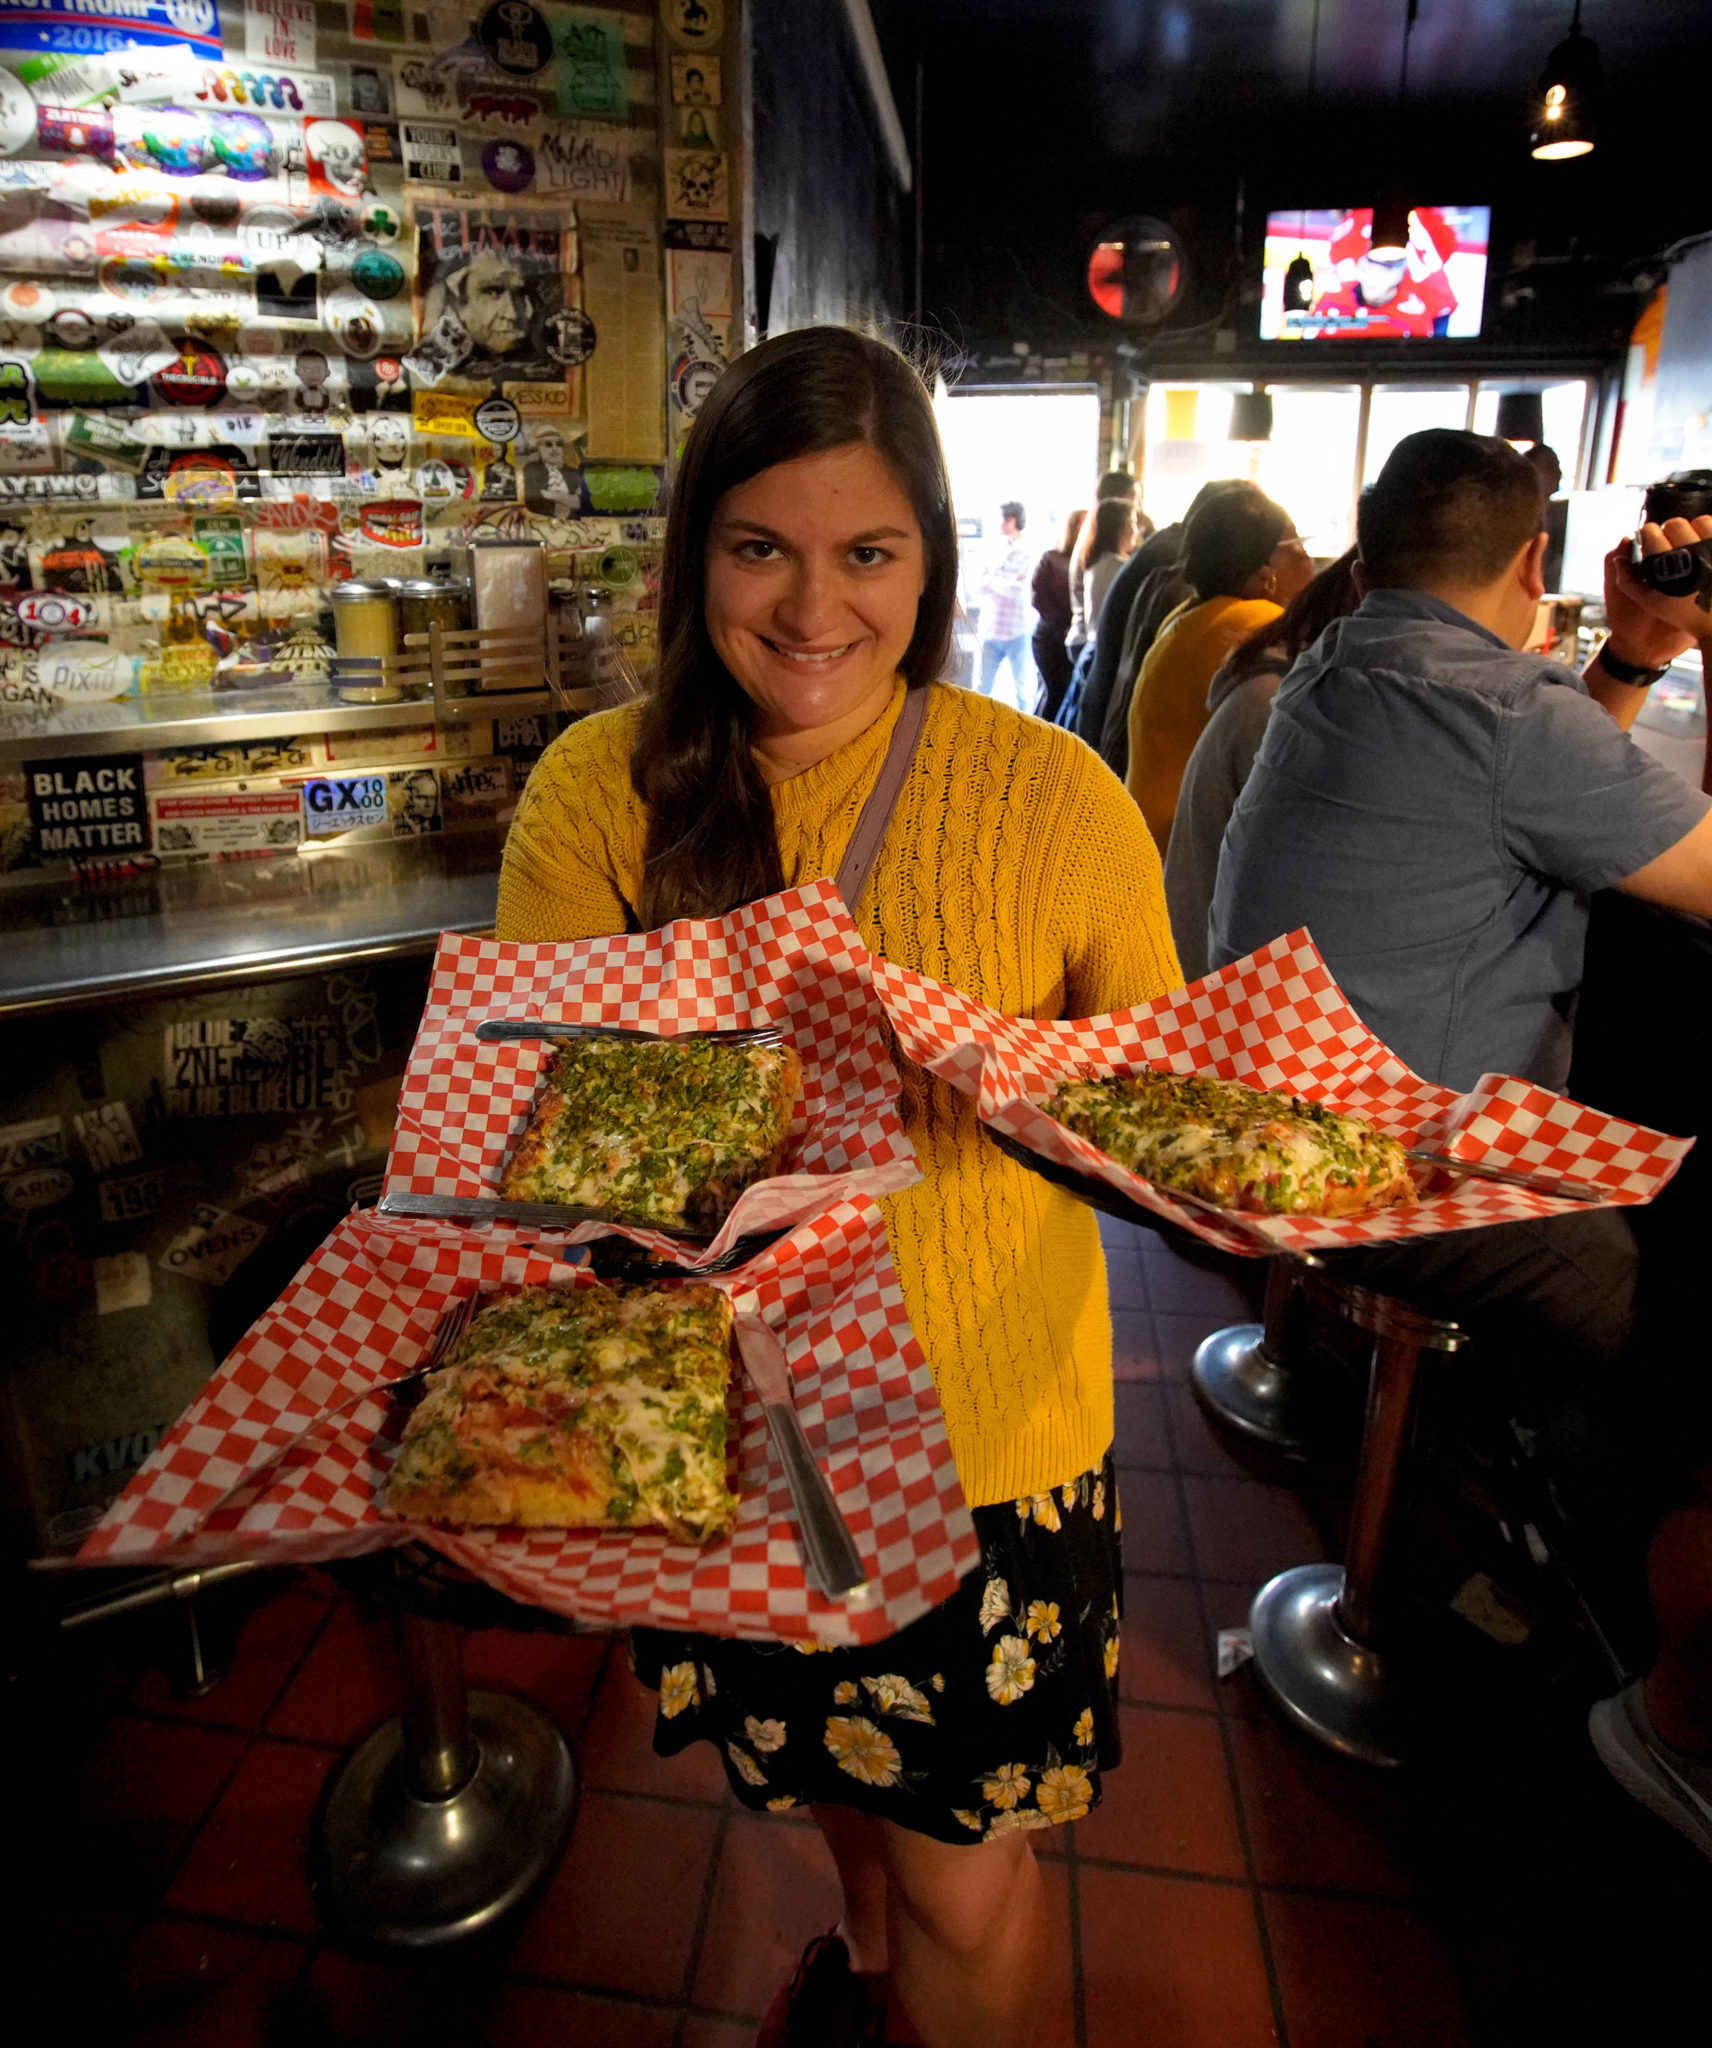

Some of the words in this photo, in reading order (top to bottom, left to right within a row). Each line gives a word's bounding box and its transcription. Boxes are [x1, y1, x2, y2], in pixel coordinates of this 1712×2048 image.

[53, 26, 124, 50] 2016
[264, 35, 296, 60] LOVE
[33, 767, 137, 797] BLACK
[42, 796, 135, 822] HOMES
[40, 821, 143, 852] MATTER
